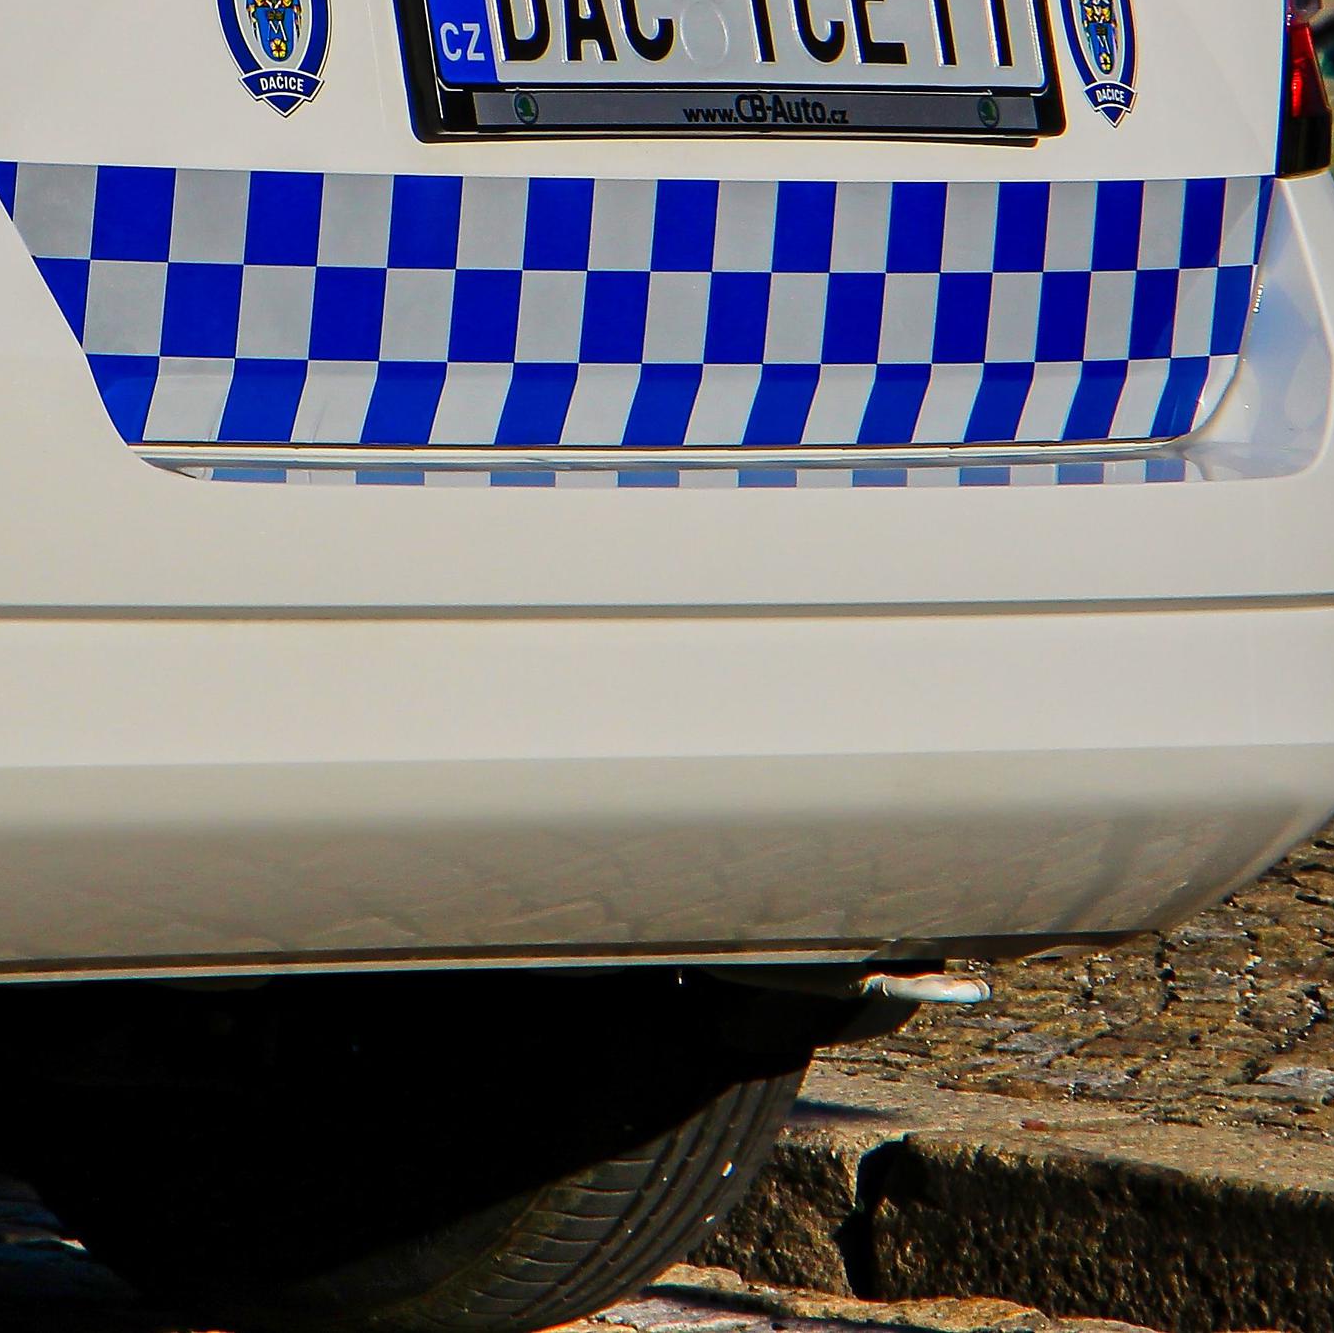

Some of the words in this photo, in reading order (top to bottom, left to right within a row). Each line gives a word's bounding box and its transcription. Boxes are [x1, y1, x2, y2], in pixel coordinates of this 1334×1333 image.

[439, 21, 486, 63] CZ
[259, 73, 304, 92] DAČICE
[1096, 85, 1125, 103] DAČICE
[682, 93, 850, 125] www.CB-Auto.cz
